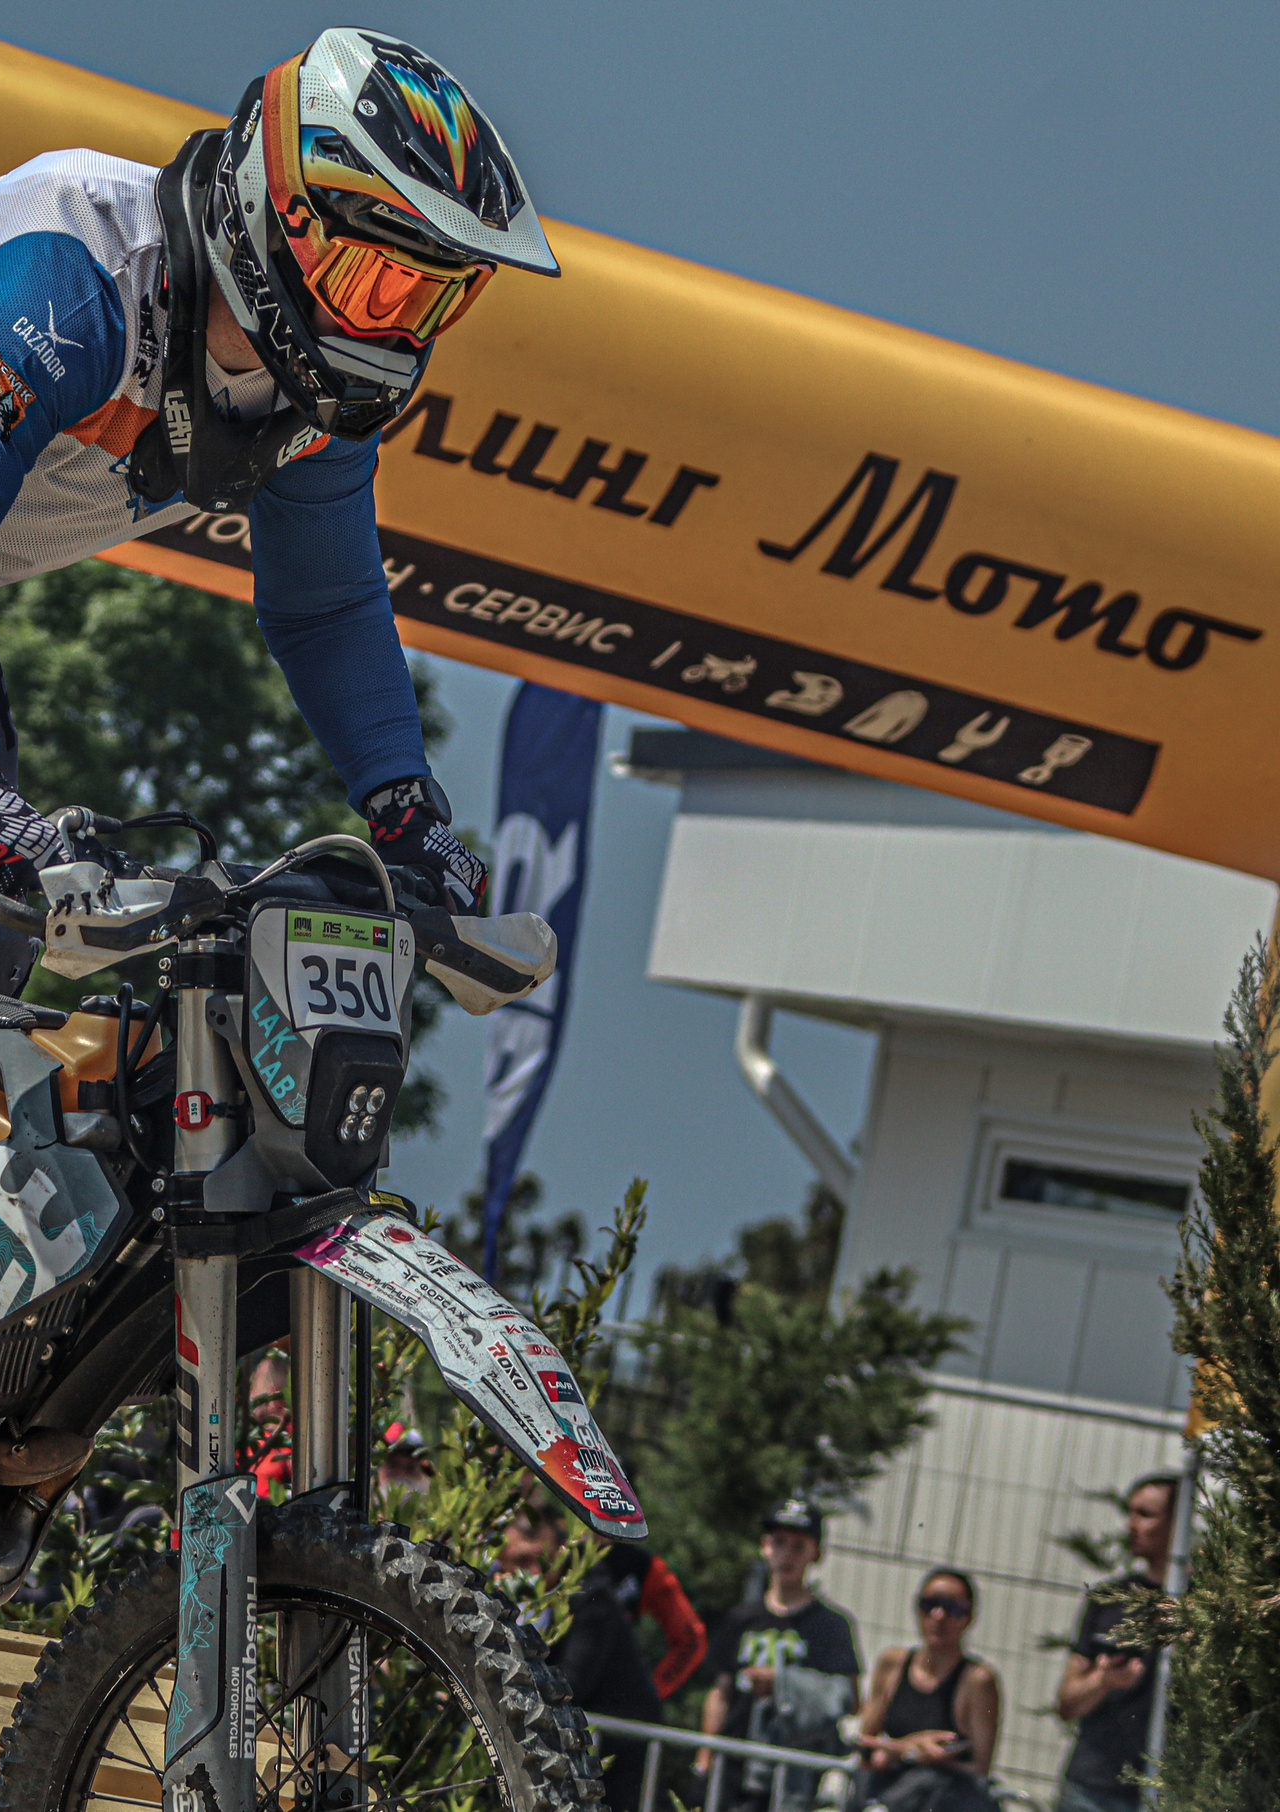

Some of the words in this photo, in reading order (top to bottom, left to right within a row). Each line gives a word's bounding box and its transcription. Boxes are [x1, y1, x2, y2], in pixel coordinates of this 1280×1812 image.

[12, 316, 66, 382] CAZADOR
[443, 581, 634, 654] СЕРВИС
[399, 939, 409, 956] 92
[301, 955, 391, 1021] 350
[251, 995, 298, 1056] LAK
[252, 1043, 296, 1099] LAB
[419, 1284, 469, 1323] ФОРСАЖ
[548, 1381, 573, 1391] LAVR
[209, 1432, 219, 1474] XACT
[586, 1474, 615, 1483] ENDURO
[583, 1489, 623, 1500] ДРУГОЙ
[600, 1499, 635, 1512] ПУТЬ
[243, 1575, 258, 1760] Husqvarna
[229, 1666, 239, 1760] MOTORCYCLES
[472, 1714, 499, 1768] EXCEL
